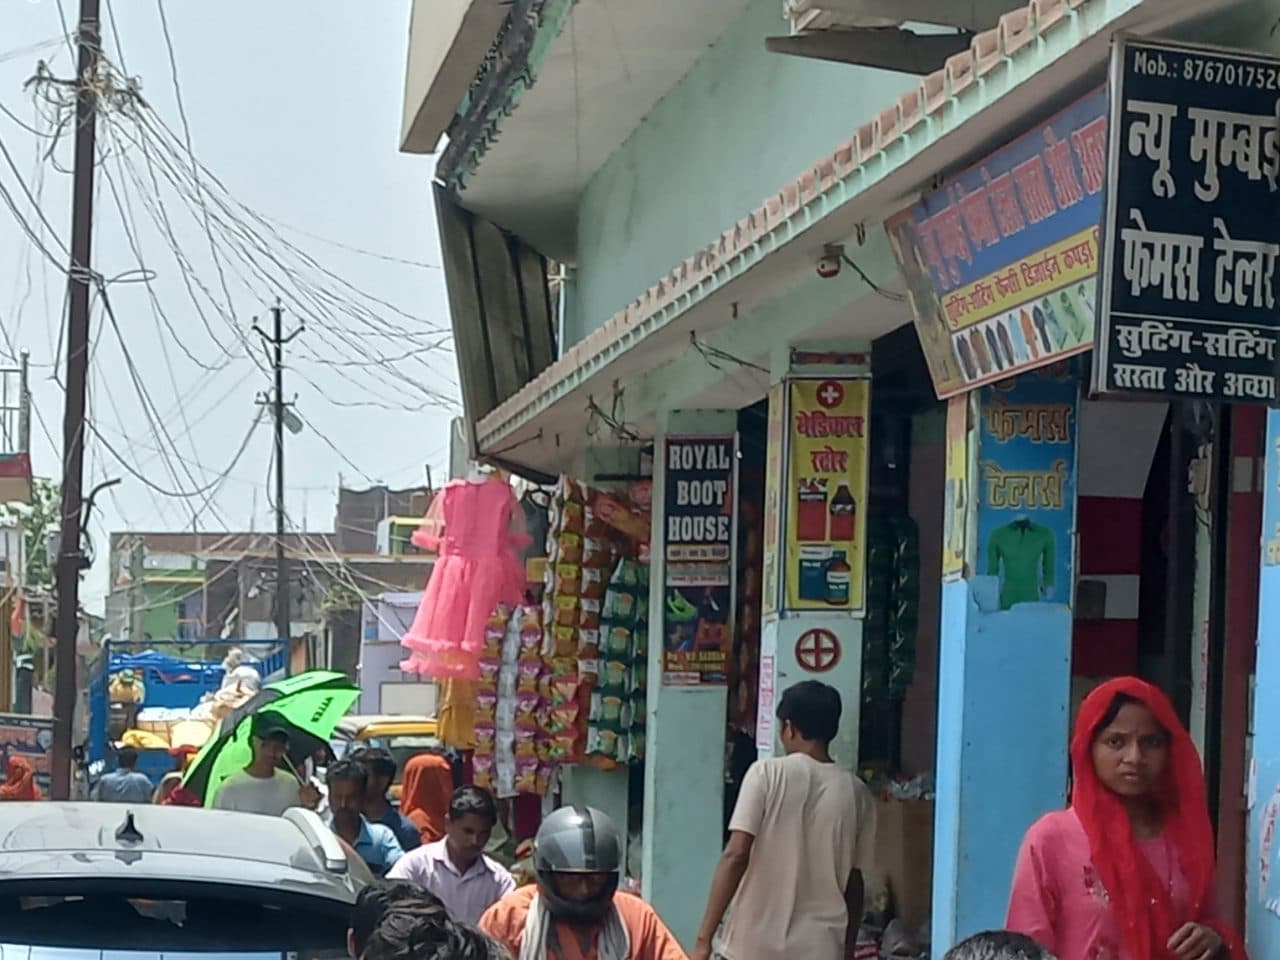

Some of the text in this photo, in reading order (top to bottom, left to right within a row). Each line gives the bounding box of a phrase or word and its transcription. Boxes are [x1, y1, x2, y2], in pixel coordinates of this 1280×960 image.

[1134, 51, 1178, 78] Mob.:
[1126, 99, 1178, 199] न्यू
[1121, 208, 1205, 302] फेमस
[1112, 362, 1276, 399] सस्ता और अच्छा
[985, 393, 1073, 444] फेमस
[669, 444, 730, 470] ROYAL
[677, 479, 726, 506] BOOT
[667, 515, 729, 541] HOUSE
